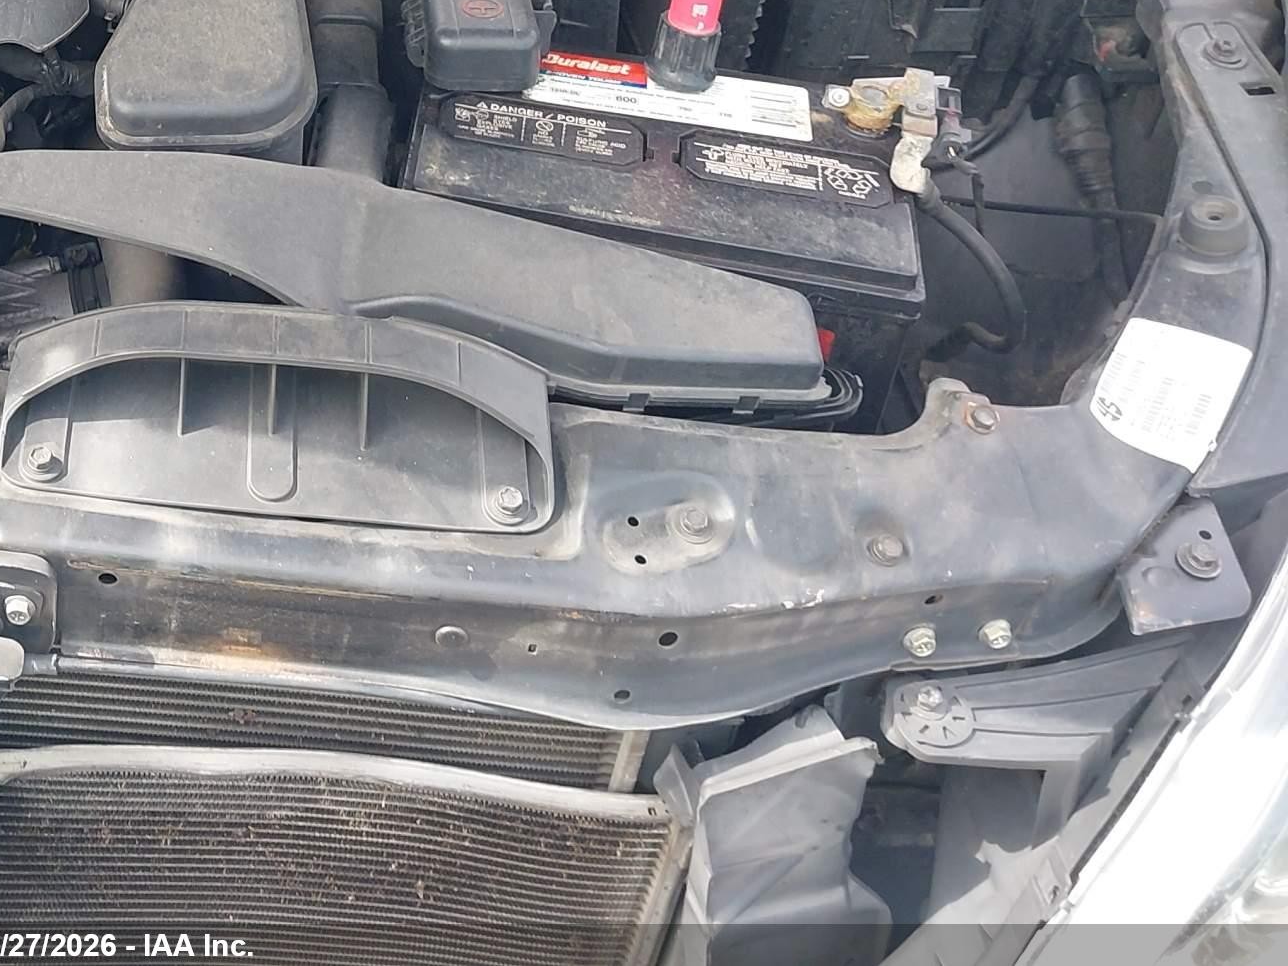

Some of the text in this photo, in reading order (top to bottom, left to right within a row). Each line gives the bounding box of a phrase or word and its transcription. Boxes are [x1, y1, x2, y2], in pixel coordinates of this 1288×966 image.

[542, 53, 632, 75] Duralast
[615, 94, 637, 104] 600
[490, 103, 544, 118] DANGER
[557, 114, 607, 128] POISON
